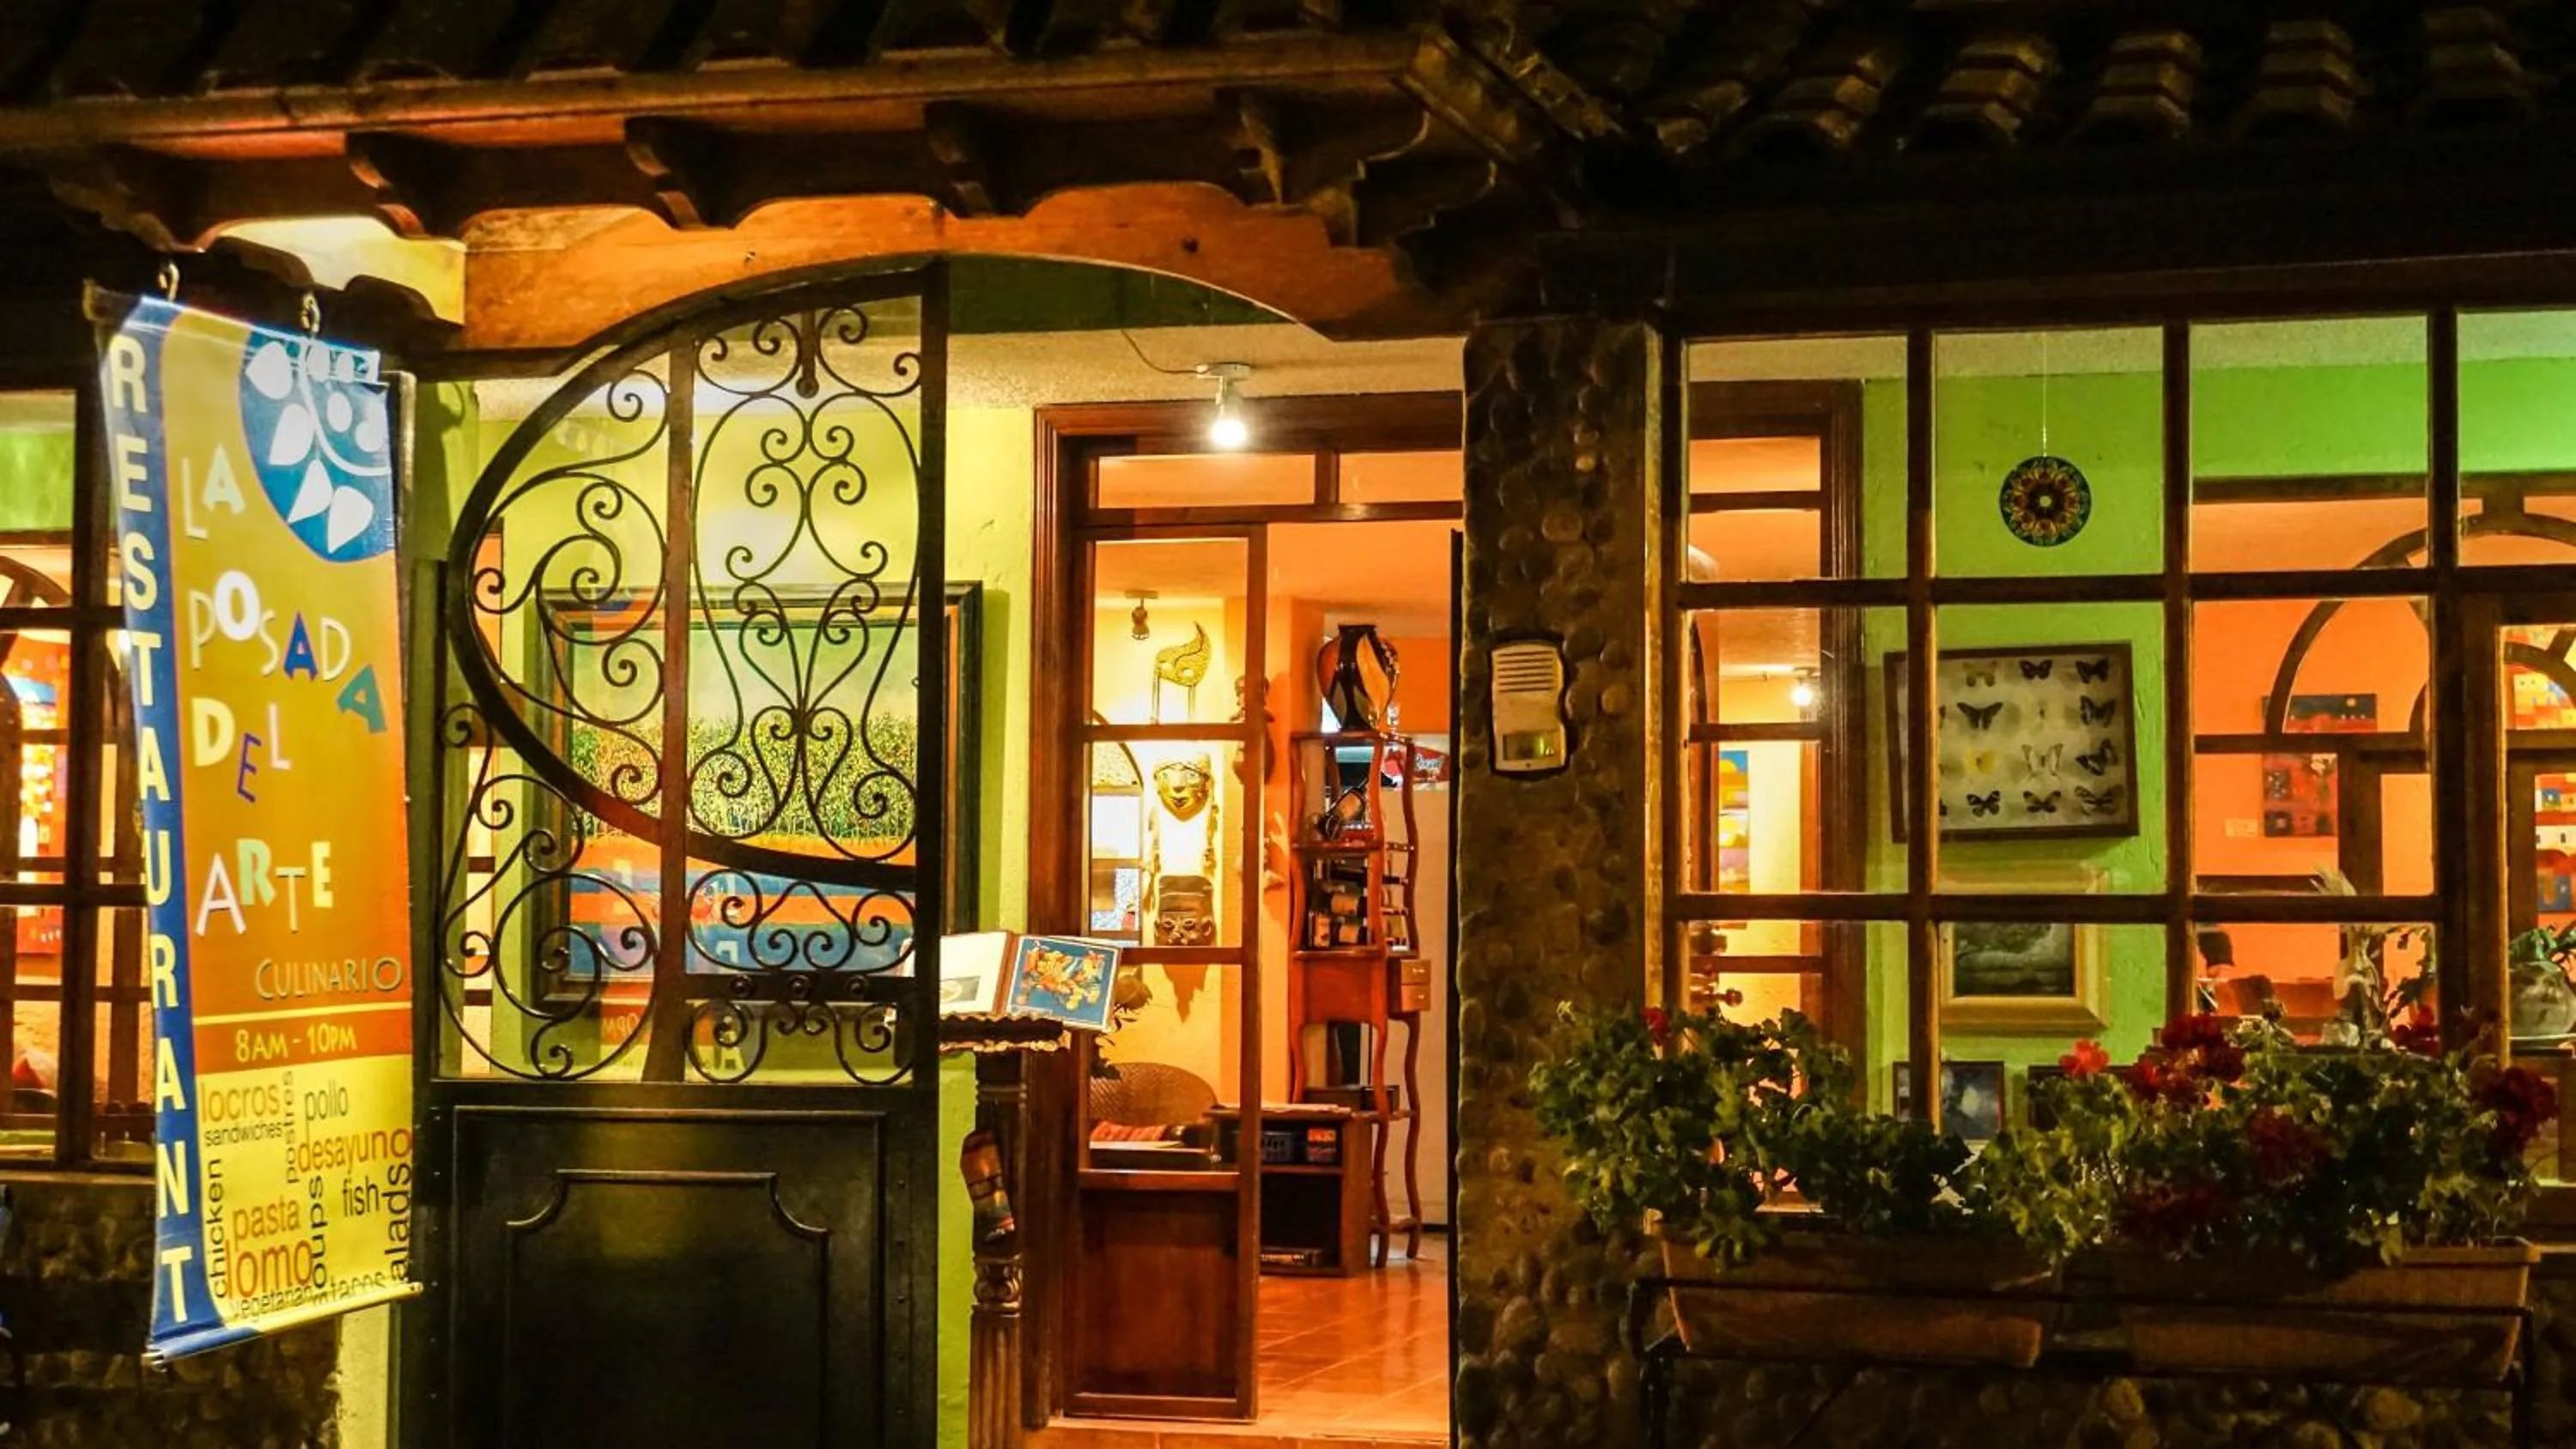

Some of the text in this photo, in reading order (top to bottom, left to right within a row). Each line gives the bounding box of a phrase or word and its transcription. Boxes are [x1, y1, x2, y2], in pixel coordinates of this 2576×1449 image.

[182, 445, 246, 540] LA
[189, 570, 387, 733] POSADA
[191, 697, 291, 803] DEL
[109, 335, 192, 1323] RESTAURANT
[196, 838, 334, 936] ARTE
[255, 956, 402, 1000] CULINARIO
[235, 1029, 289, 1064] 8AM
[306, 1022, 358, 1054] 10PM
[201, 1082, 280, 1124] locros
[305, 1078, 349, 1125] pollo
[205, 1119, 283, 1148] sandwiches
[298, 1123, 411, 1174] desayuno
[233, 1195, 301, 1252] pasta
[342, 1176, 380, 1217] fish
[381, 1162, 411, 1282] alads
[206, 1158, 227, 1299] chicken
[225, 1240, 314, 1300] lomo
